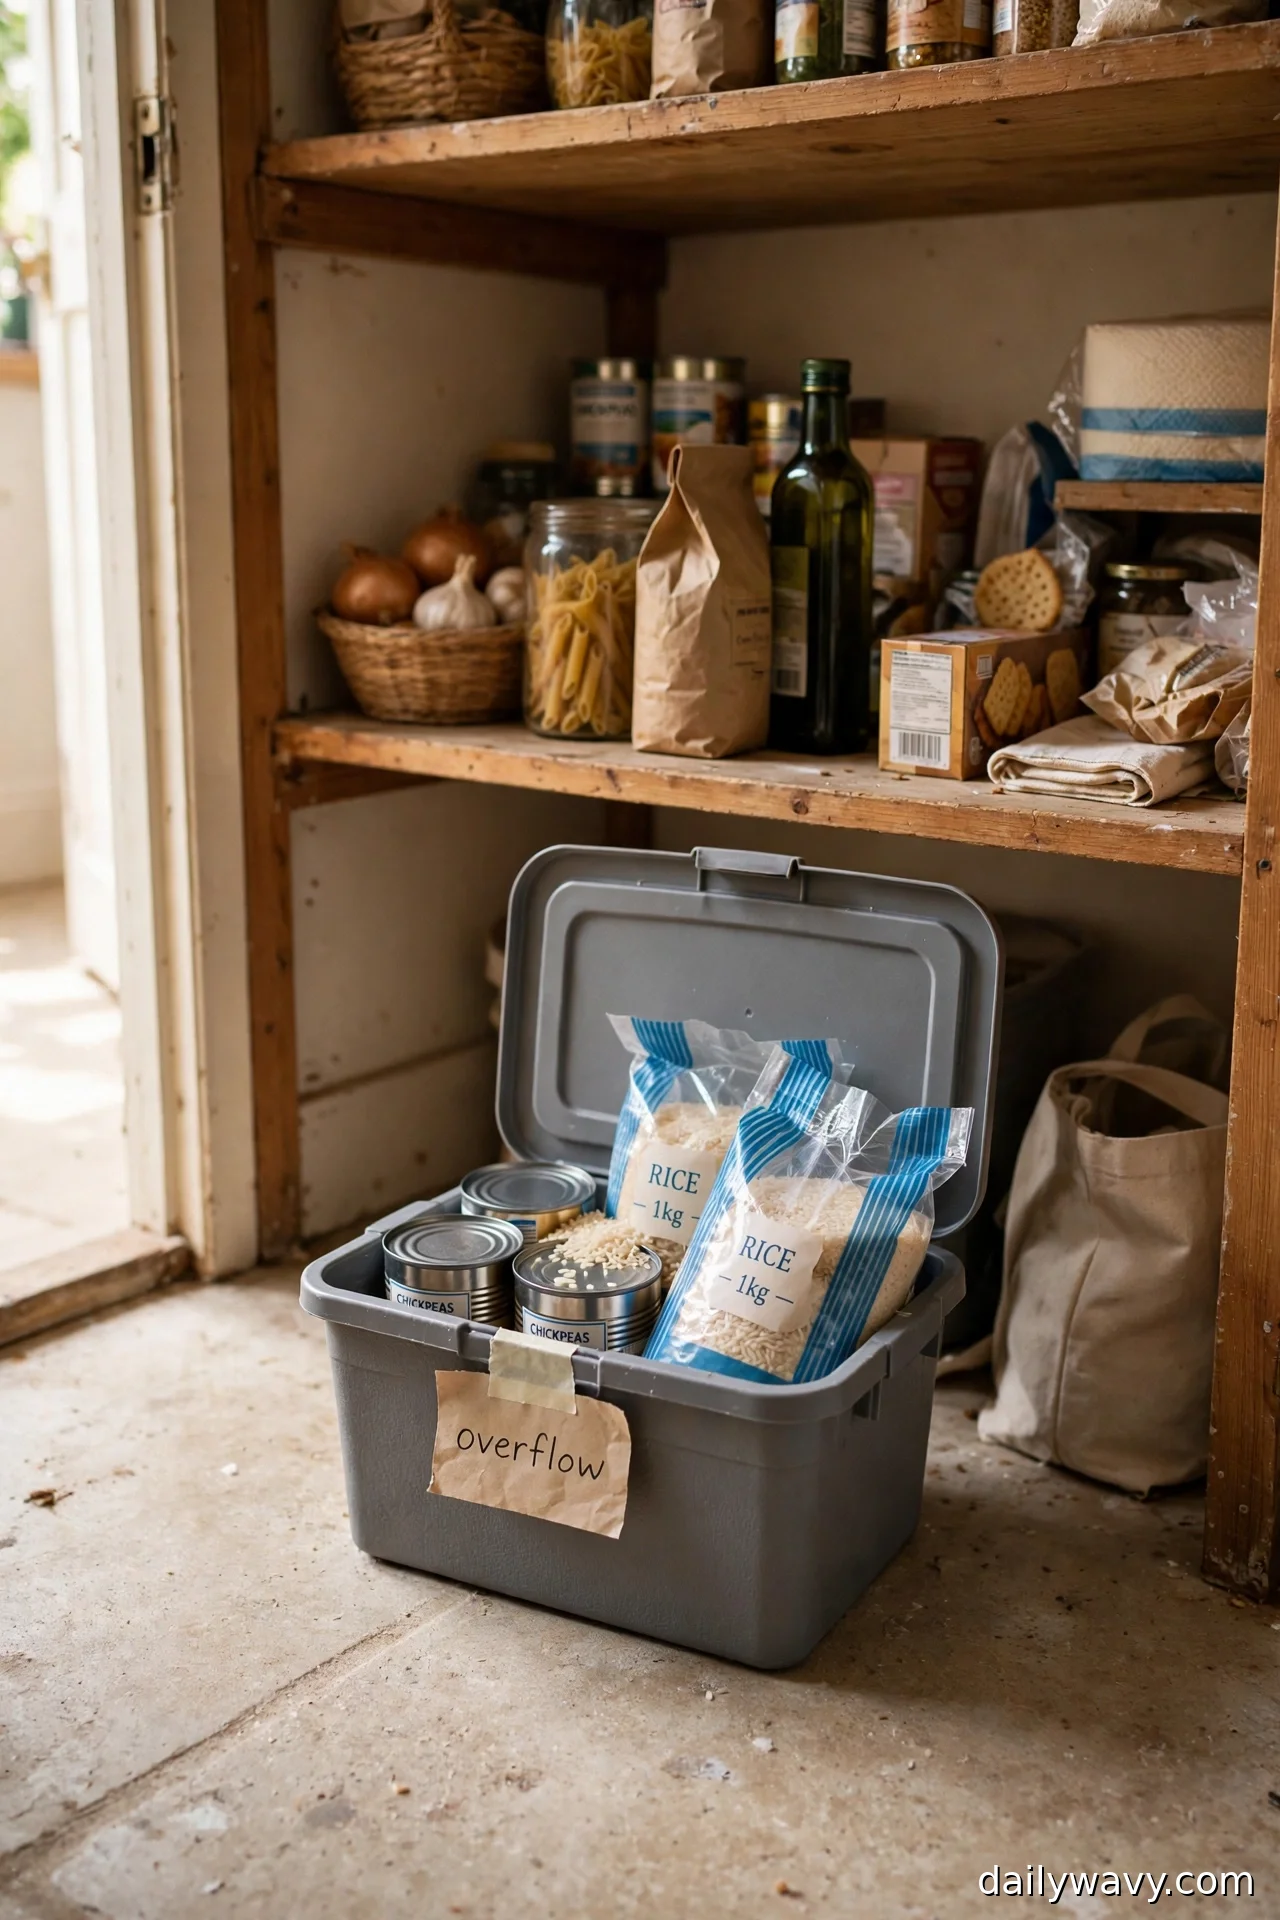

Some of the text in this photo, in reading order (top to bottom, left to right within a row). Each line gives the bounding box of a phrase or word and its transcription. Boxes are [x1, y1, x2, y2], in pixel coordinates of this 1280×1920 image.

[648, 1163, 701, 1194] RICE
[653, 1200, 684, 1228] 1kg
[738, 1235, 797, 1273] RICE
[396, 1293, 454, 1313] CHICKPEAS
[735, 1274, 770, 1306] 1kg
[530, 1323, 590, 1343] CHICKPEAS
[456, 1428, 605, 1480] overflow
